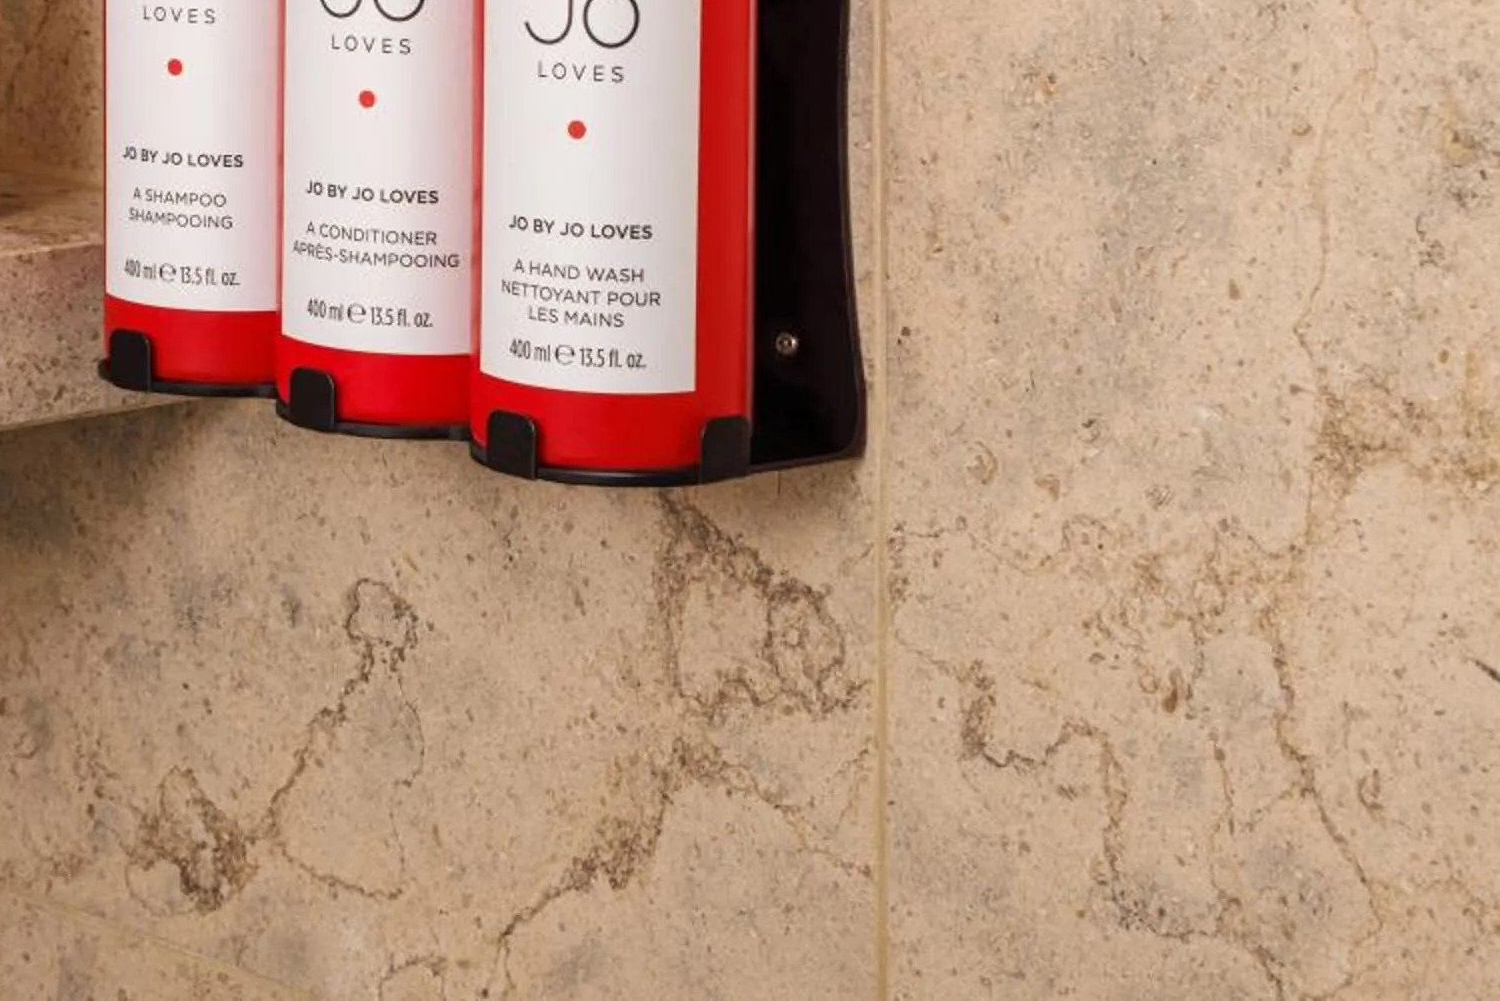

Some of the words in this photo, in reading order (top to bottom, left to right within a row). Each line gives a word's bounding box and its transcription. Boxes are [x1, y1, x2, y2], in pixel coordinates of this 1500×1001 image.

[143, 6, 216, 25] LOVES
[331, 35, 412, 55] LOVES
[537, 60, 625, 84] LOVES
[122, 146, 137, 160] JO
[141, 149, 158, 163] BY
[162, 152, 183, 166] JO
[187, 153, 244, 168] LOVES
[133, 187, 141, 199] A
[145, 188, 227, 208] SHAMPOO
[306, 180, 323, 195] JO
[327, 184, 347, 199] BY
[352, 187, 374, 202] JO
[380, 189, 439, 204] LOVES
[128, 207, 233, 230] SHAMPOOING
[509, 214, 528, 231] JO
[533, 218, 555, 234] BY
[560, 222, 585, 237] JO
[591, 224, 653, 240] LOVES
[306, 221, 315, 234] A
[319, 223, 437, 246] CONDITIONER
[293, 239, 461, 268] APRÈS-SHAMPOOING
[124, 258, 141, 278] 400
[143, 263, 157, 280] ml
[180, 266, 202, 286] 13.5
[221, 272, 240, 286] oz.
[513, 258, 525, 273] A
[529, 261, 580, 279] HAND
[586, 266, 644, 283] WASH
[501, 279, 600, 305] NETTOYANT
[607, 291, 661, 307] POUR
[307, 298, 327, 319] 400
[329, 303, 343, 321] ml
[371, 307, 394, 326] 13.5
[397, 307, 410, 327] fl.
[414, 312, 433, 328] oz.
[528, 306, 559, 323] LES
[564, 310, 625, 328] MAINS
[509, 338, 531, 360] 400
[534, 344, 550, 363] ml
[579, 348, 605, 368] 13.5
[609, 349, 622, 368] fl.
[626, 354, 647, 369] oz.
